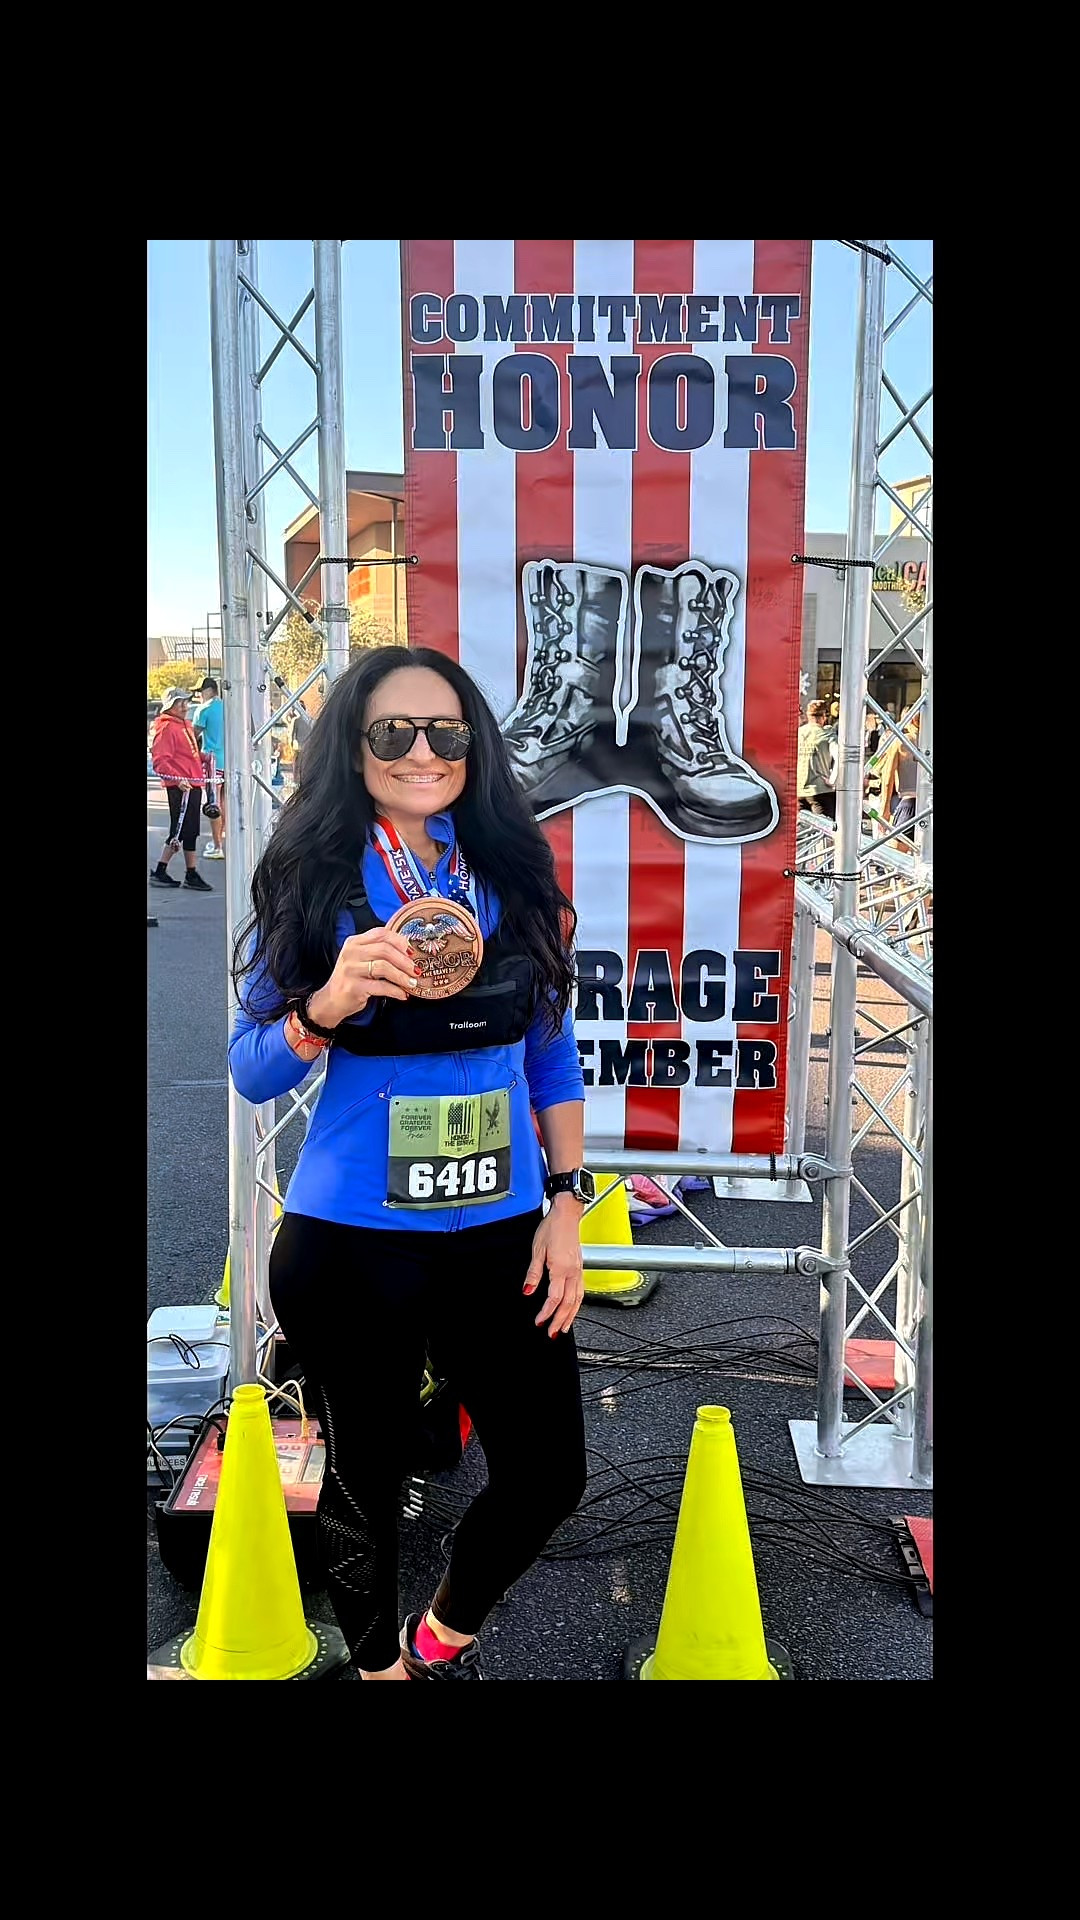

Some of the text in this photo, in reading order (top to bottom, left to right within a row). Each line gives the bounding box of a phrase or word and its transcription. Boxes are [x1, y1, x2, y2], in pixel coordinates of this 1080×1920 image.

[409, 292, 800, 344] COMMITMENT
[410, 352, 798, 453] HONOR
[902, 560, 927, 592] CA
[391, 848, 407, 867] 5K
[413, 950, 478, 973] ONOR
[574, 949, 781, 1023] RAGE
[577, 1038, 777, 1089] MBER
[408, 1155, 498, 1199] 6416
